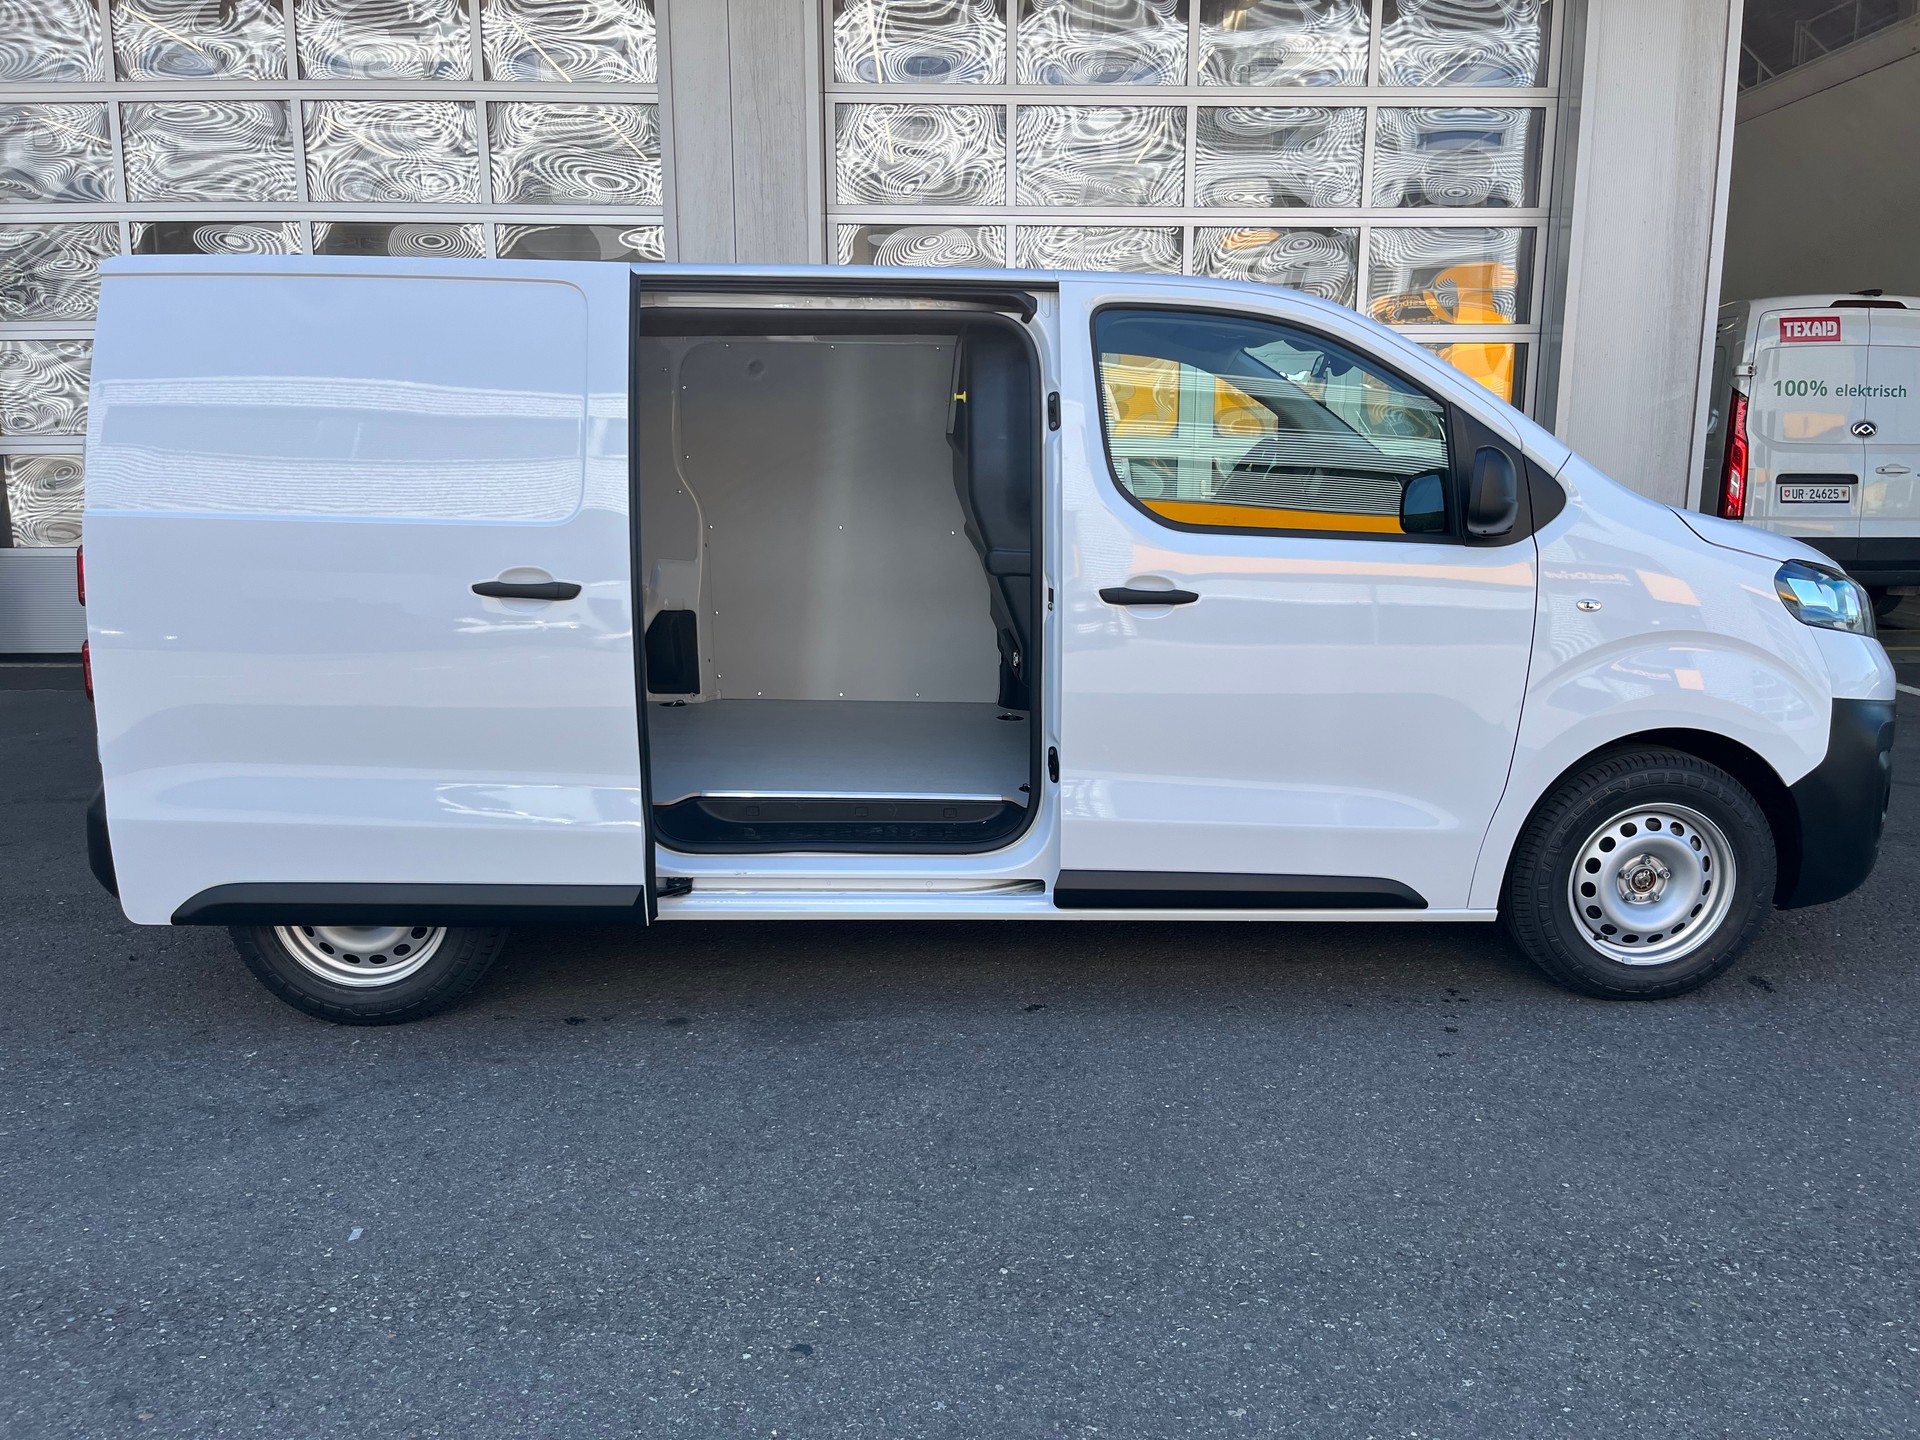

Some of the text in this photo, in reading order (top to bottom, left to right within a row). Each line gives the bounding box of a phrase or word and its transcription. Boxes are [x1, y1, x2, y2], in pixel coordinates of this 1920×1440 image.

[1783, 321, 1838, 337] TEXAID
[1773, 380, 1907, 398] 100% elektrisch
